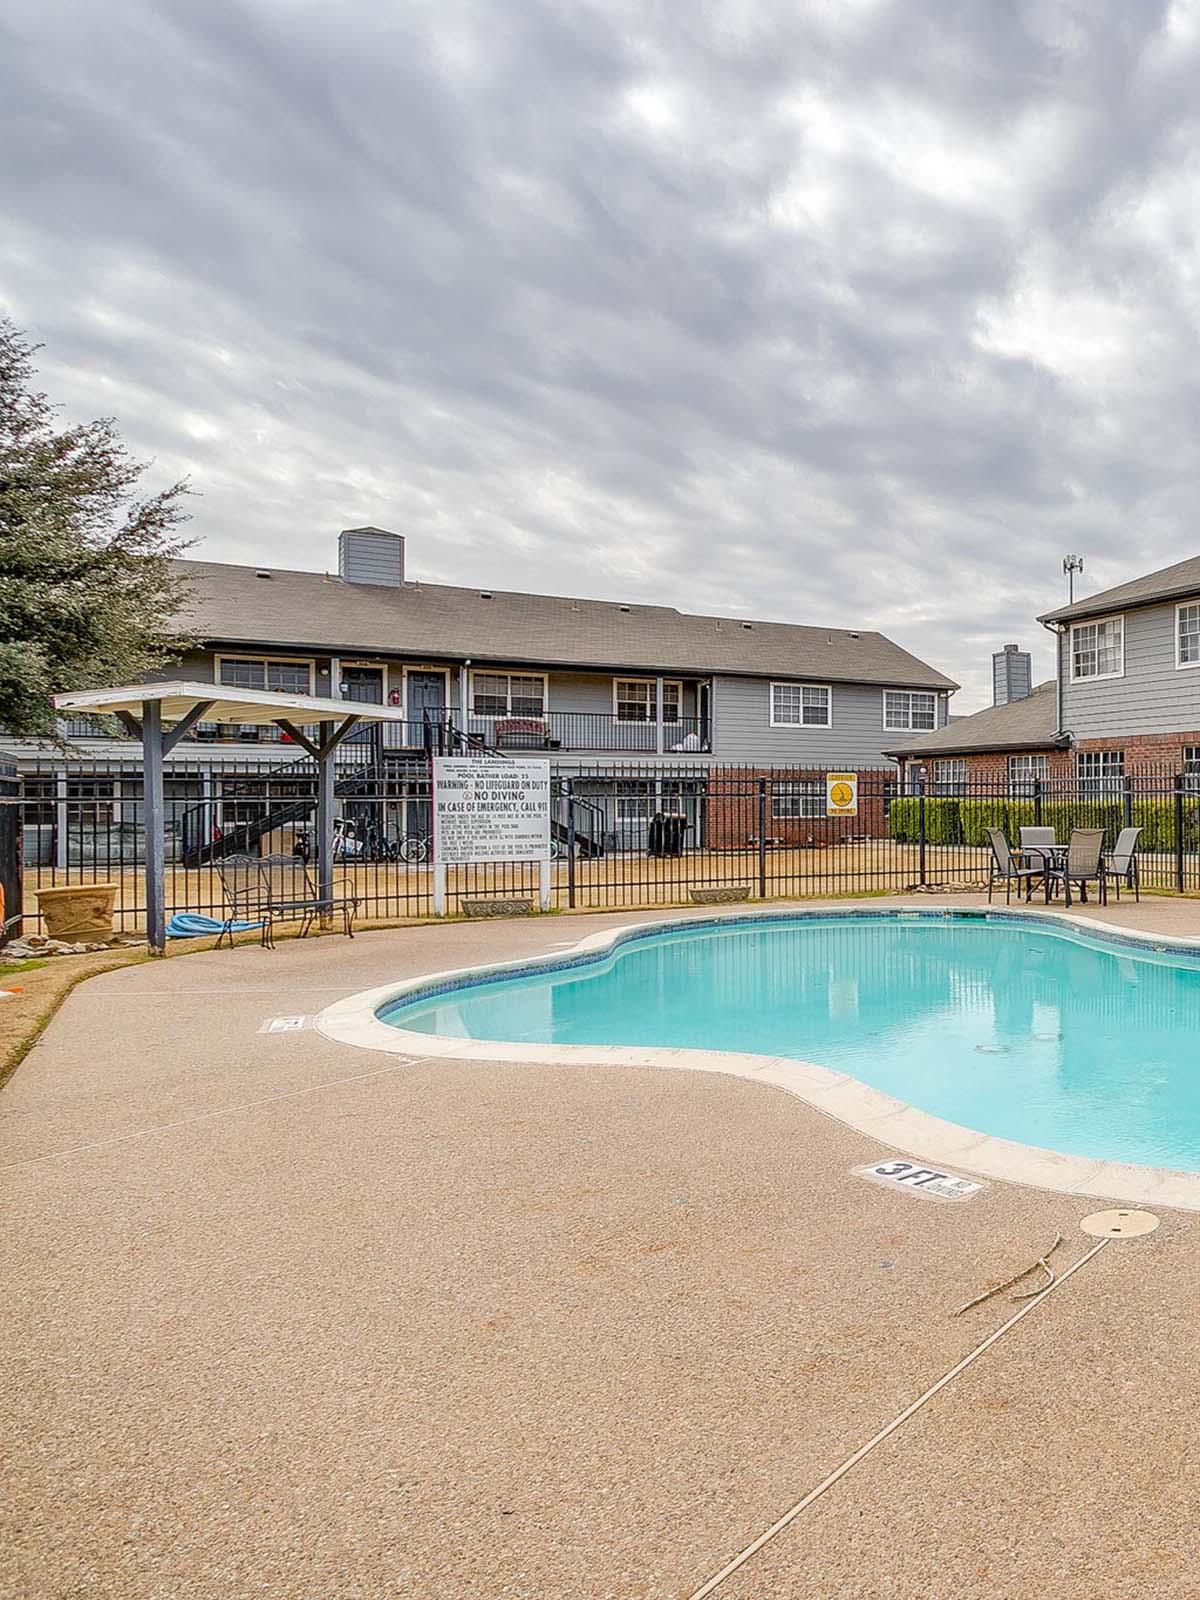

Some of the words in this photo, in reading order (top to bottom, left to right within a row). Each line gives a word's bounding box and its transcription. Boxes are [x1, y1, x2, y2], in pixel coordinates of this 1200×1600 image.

[437, 780, 468, 789] WARNING
[475, 780, 484, 789] NO
[486, 780, 520, 790] LIFEGUARD
[521, 781, 530, 790] ON
[532, 781, 548, 790] DUTY
[474, 791, 489, 800] NO
[491, 791, 525, 800] DIVING
[438, 802, 446, 812] IN
[447, 802, 464, 812] CASE
[466, 802, 475, 811] OF
[477, 802, 518, 812] EMERGENCY,
[521, 802, 536, 811] CALL
[538, 802, 548, 811] 911
[875, 1163, 913, 1175] 3
